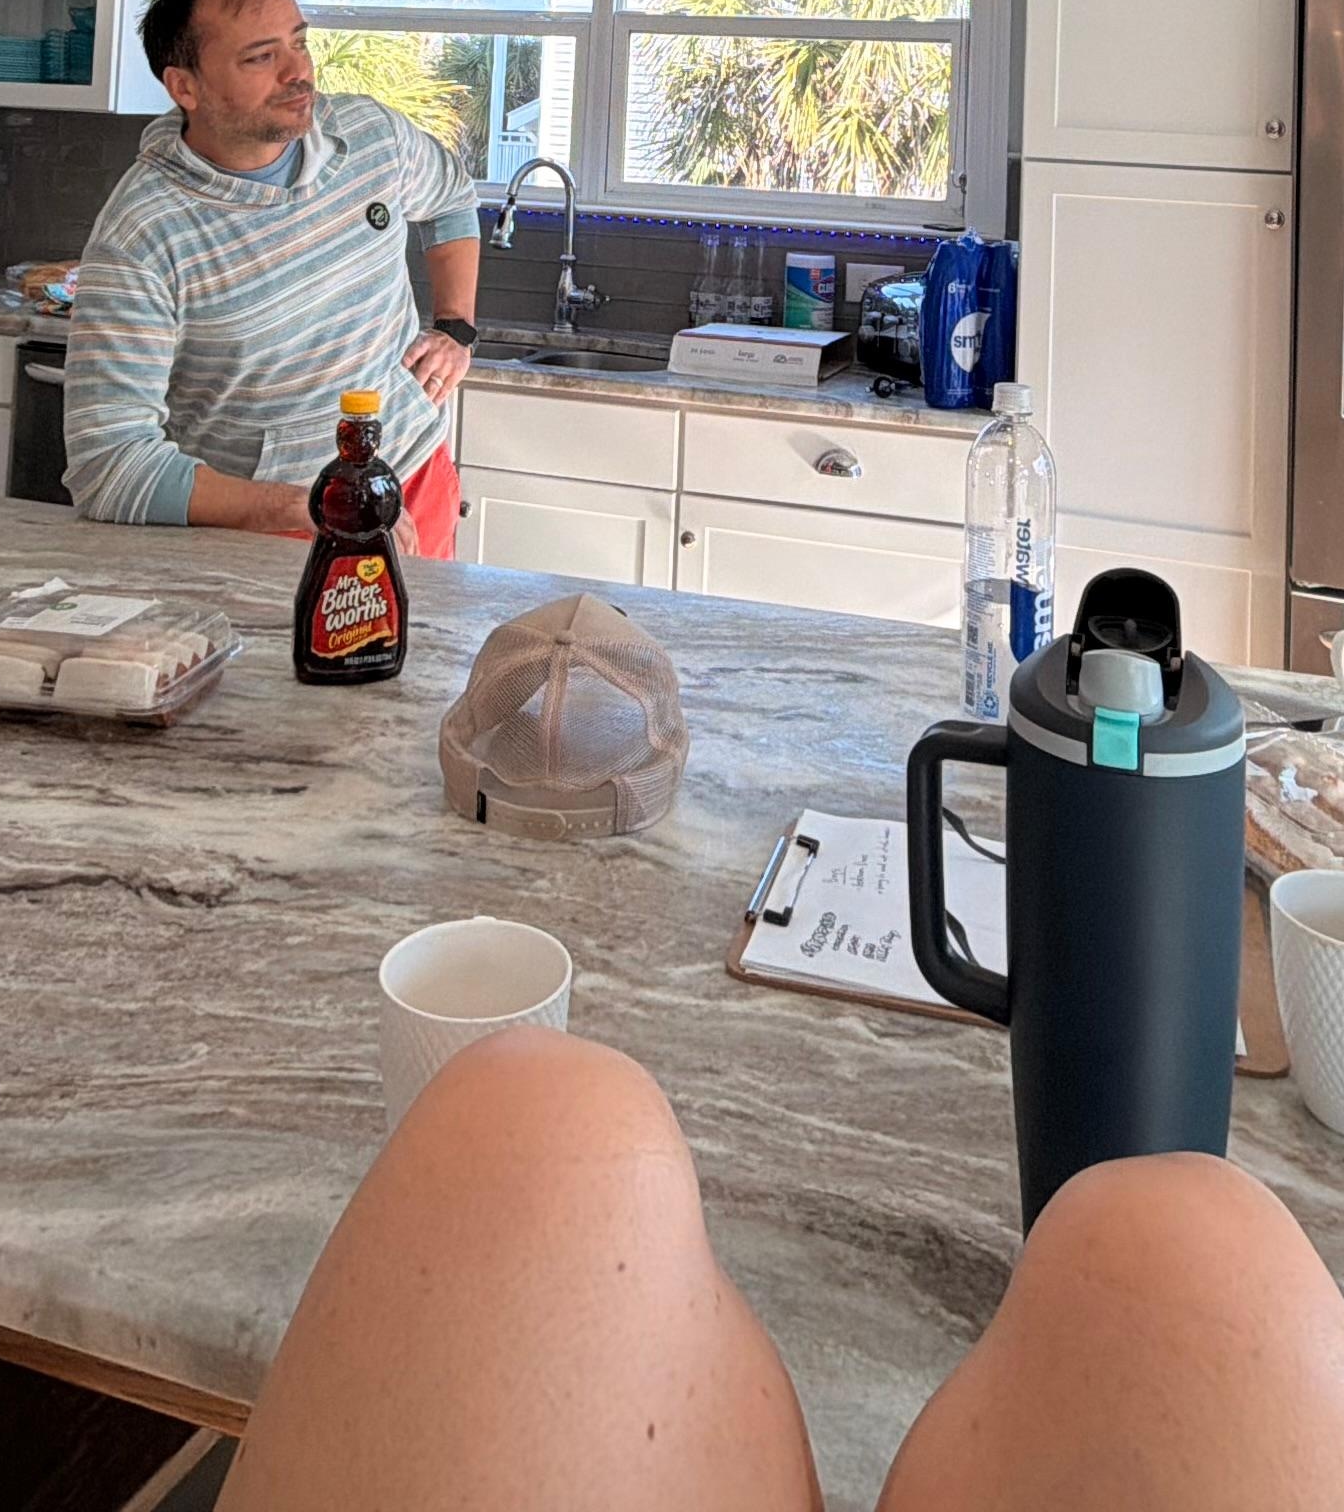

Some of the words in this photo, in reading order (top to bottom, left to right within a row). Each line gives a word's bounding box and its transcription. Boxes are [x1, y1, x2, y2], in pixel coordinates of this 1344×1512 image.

[322, 583, 382, 615] Butter-
[325, 596, 388, 632] worth's
[329, 621, 373, 649] Original
